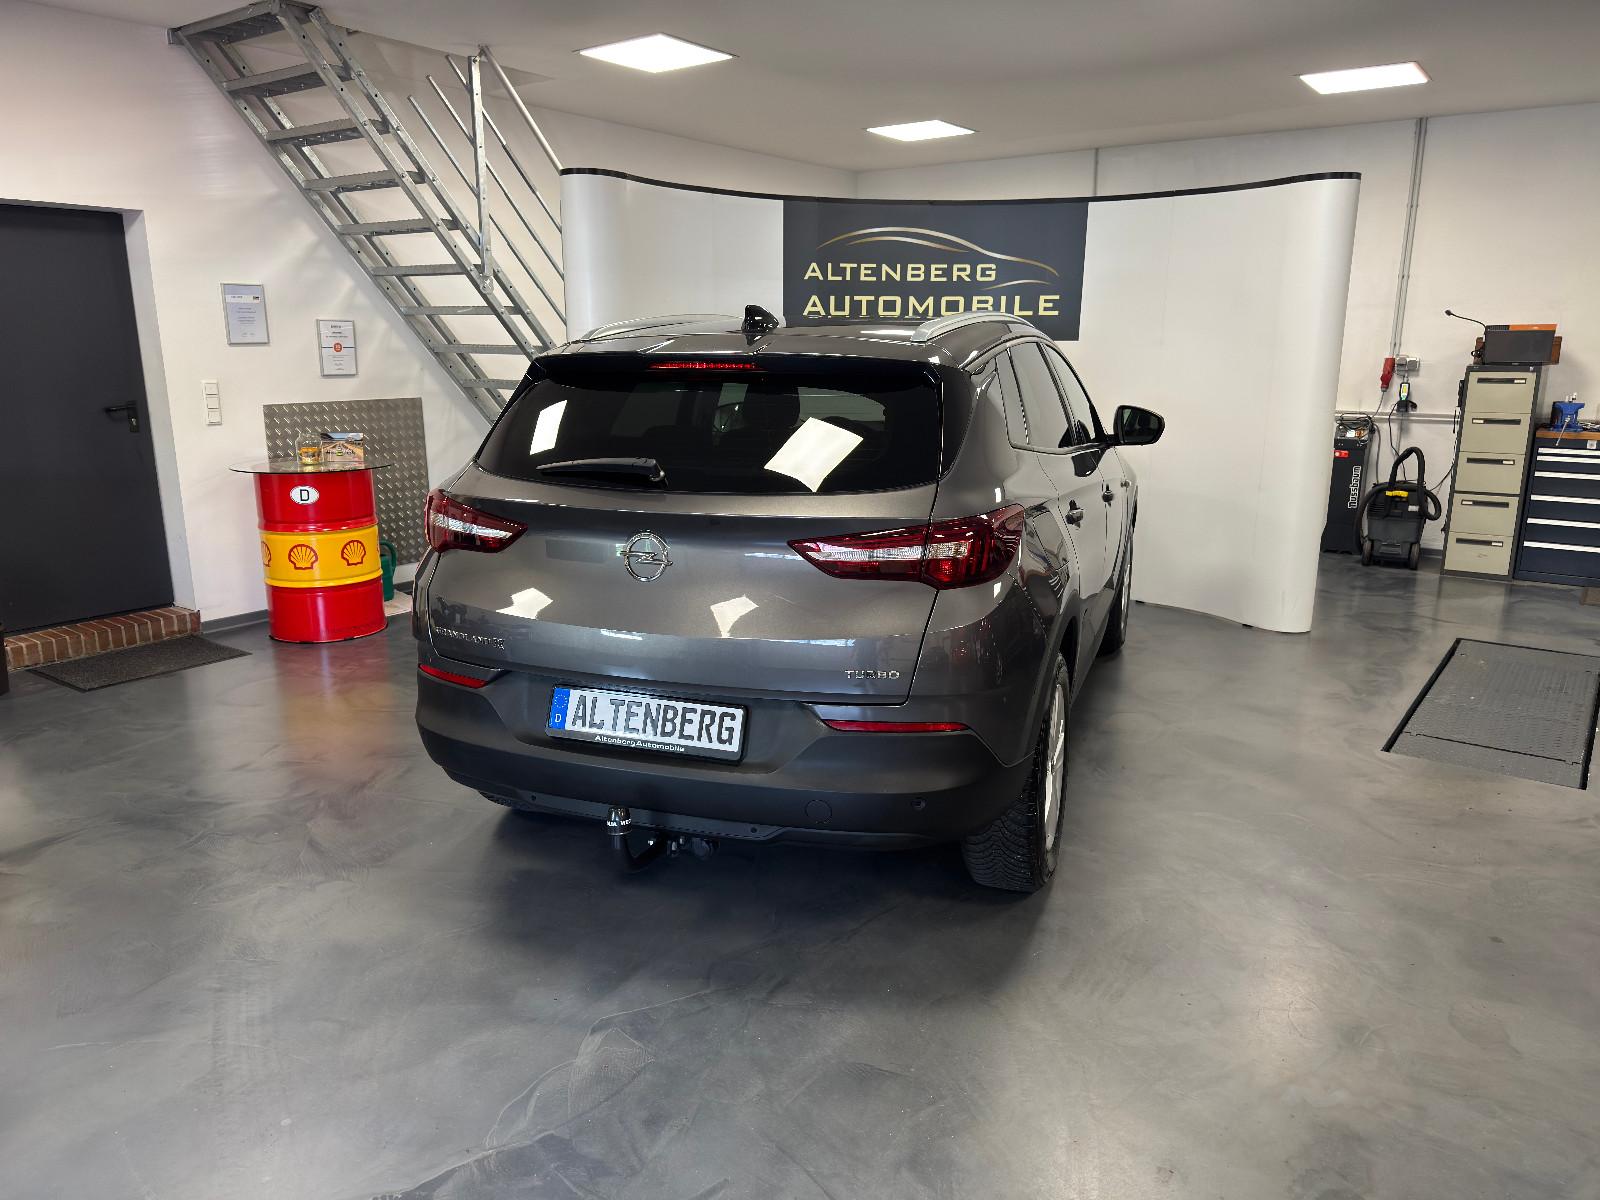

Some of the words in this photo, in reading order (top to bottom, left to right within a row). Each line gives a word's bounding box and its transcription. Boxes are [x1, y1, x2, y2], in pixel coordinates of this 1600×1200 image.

[803, 262, 997, 282] ALTENBERG
[802, 295, 1060, 317] AUTOMOBILE
[299, 488, 310, 502] D
[844, 670, 900, 680] TURBO
[554, 714, 562, 723] D
[594, 735, 636, 748] Altenberg
[635, 740, 685, 752] Automobile
